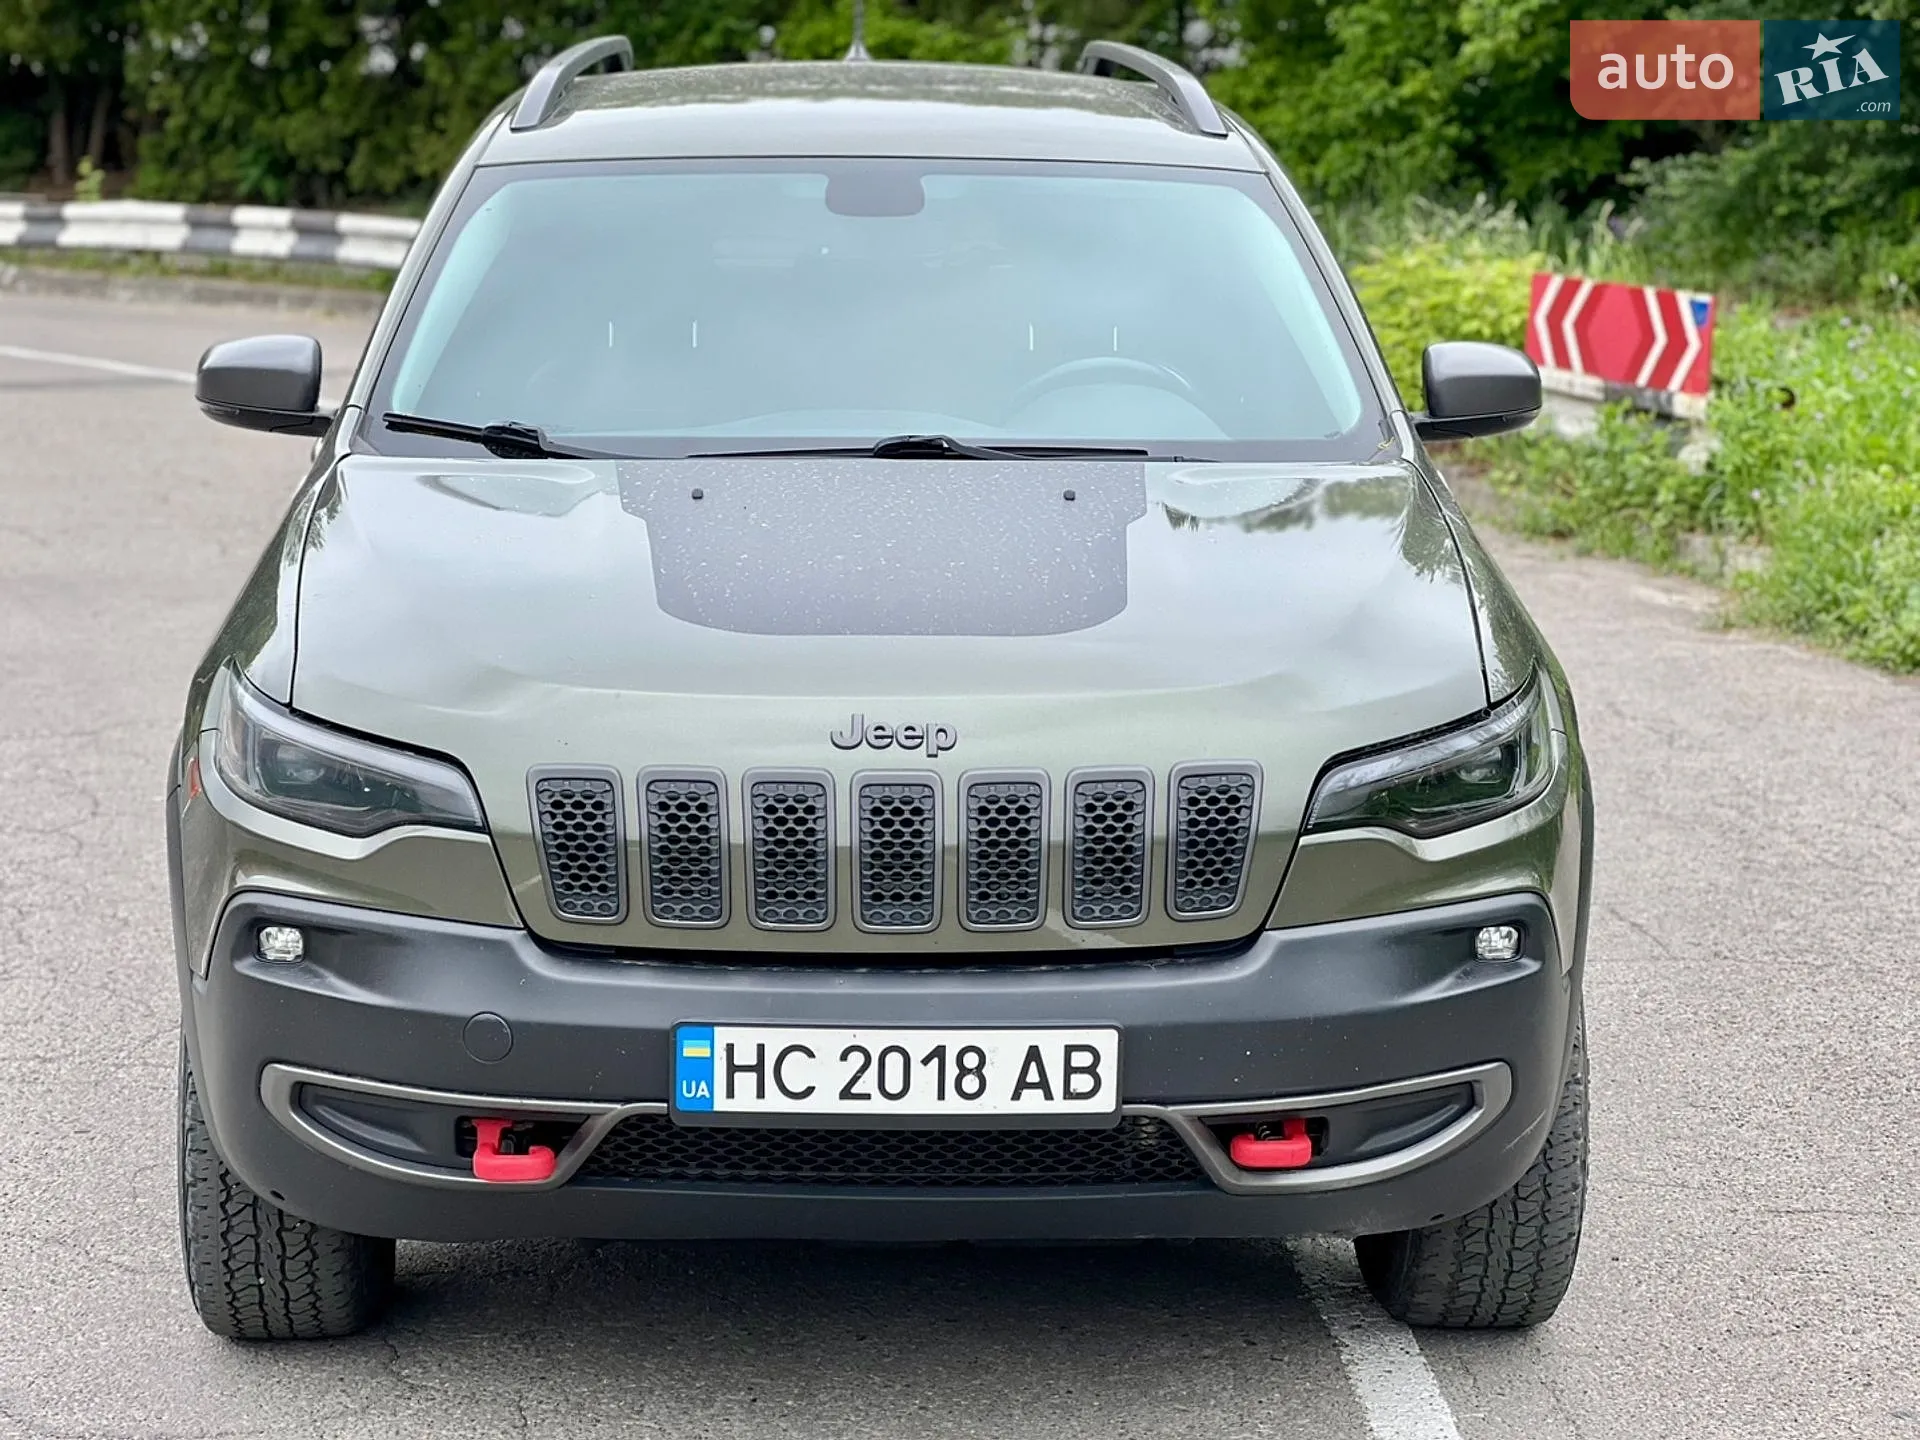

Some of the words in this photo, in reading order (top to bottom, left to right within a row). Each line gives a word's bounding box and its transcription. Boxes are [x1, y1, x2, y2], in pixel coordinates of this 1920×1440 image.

[830, 713, 957, 758] Jeep
[682, 1080, 710, 1098] UA
[725, 1043, 816, 1100] HC
[838, 1044, 987, 1101] 2018
[1011, 1044, 1102, 1101] AB
